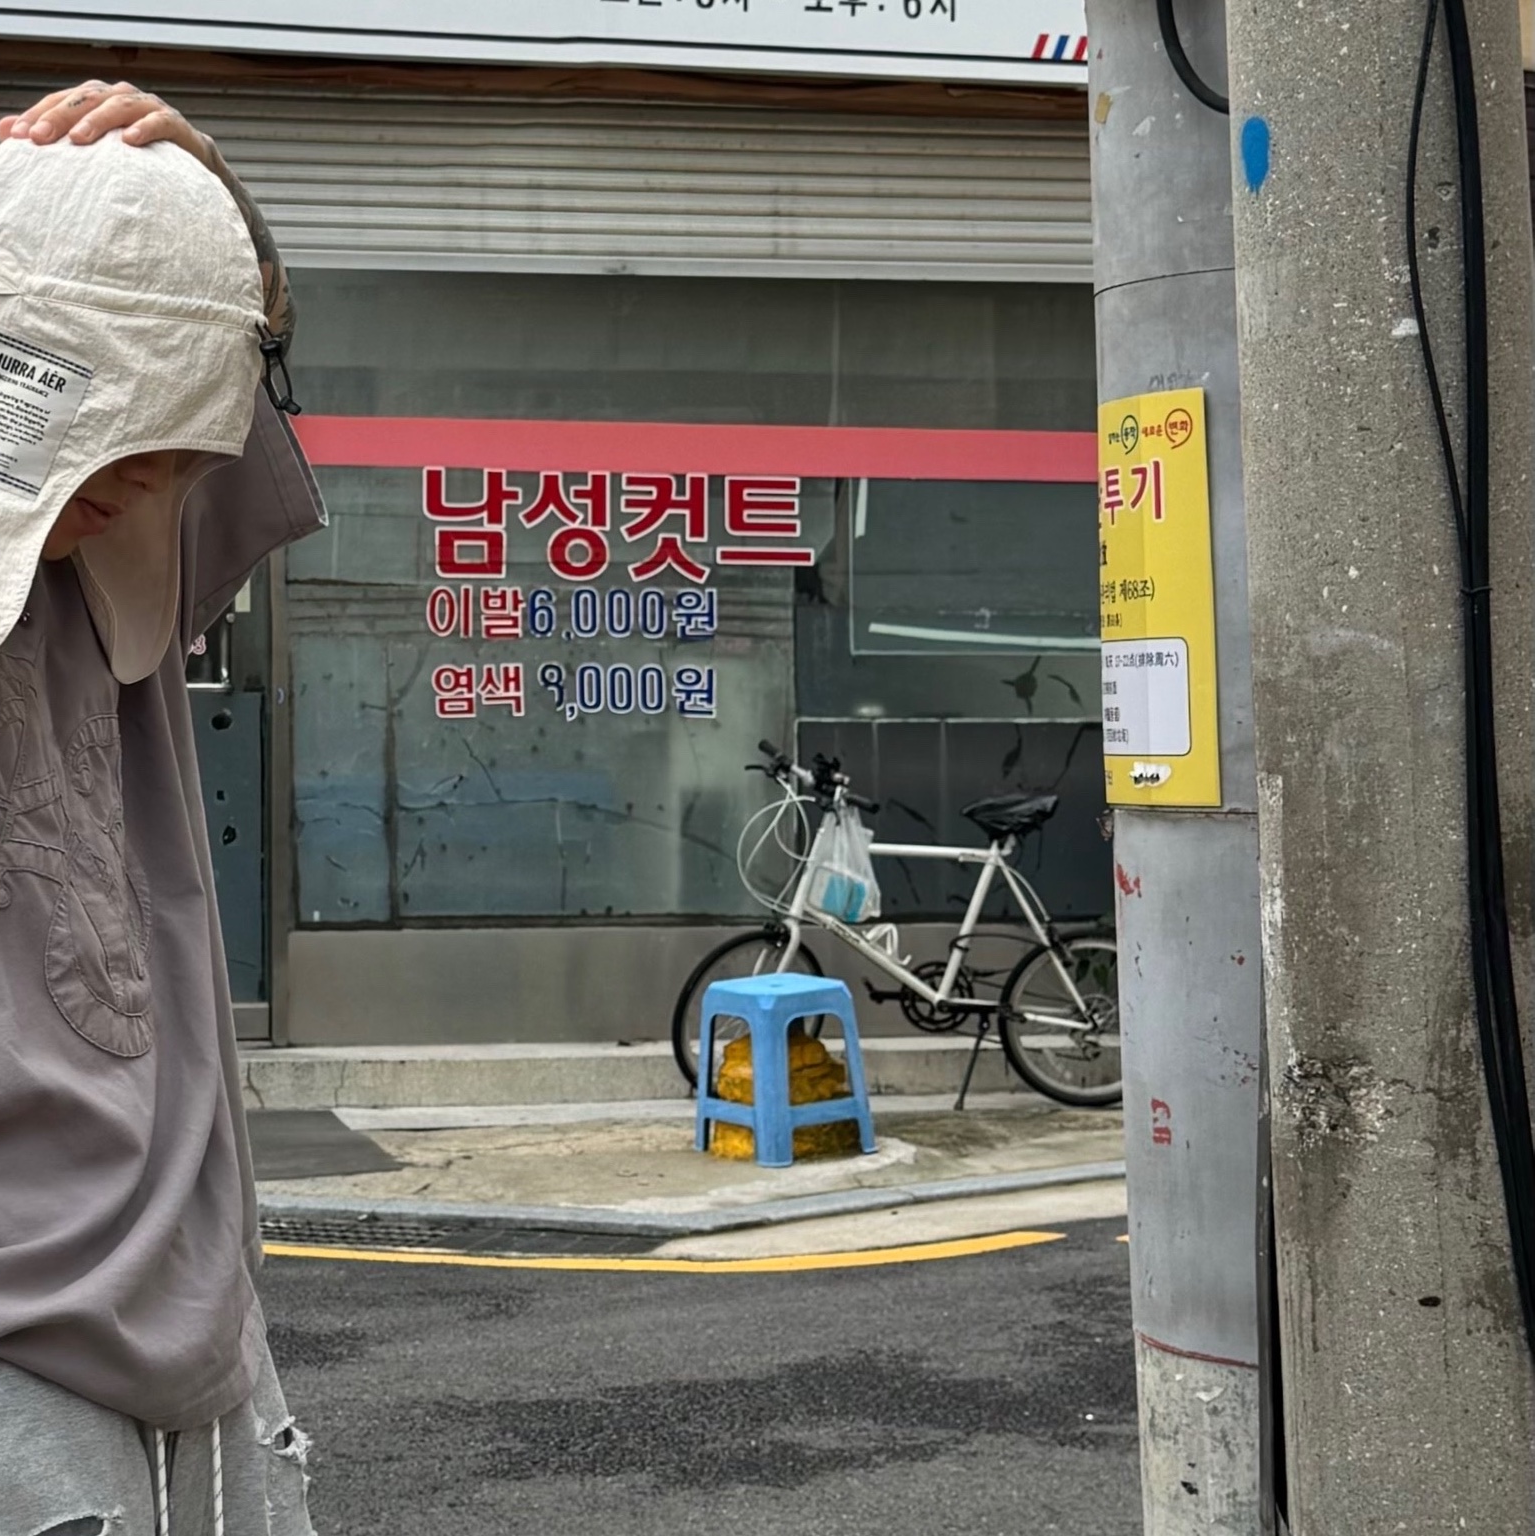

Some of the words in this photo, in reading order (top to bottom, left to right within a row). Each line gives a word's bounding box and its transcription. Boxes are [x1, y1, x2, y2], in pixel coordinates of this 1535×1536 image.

[422, 466, 815, 583] 남성컷트
[426, 585, 527, 640] 이발
[528, 586, 717, 642] 6,000원
[432, 663, 525, 719] 염색
